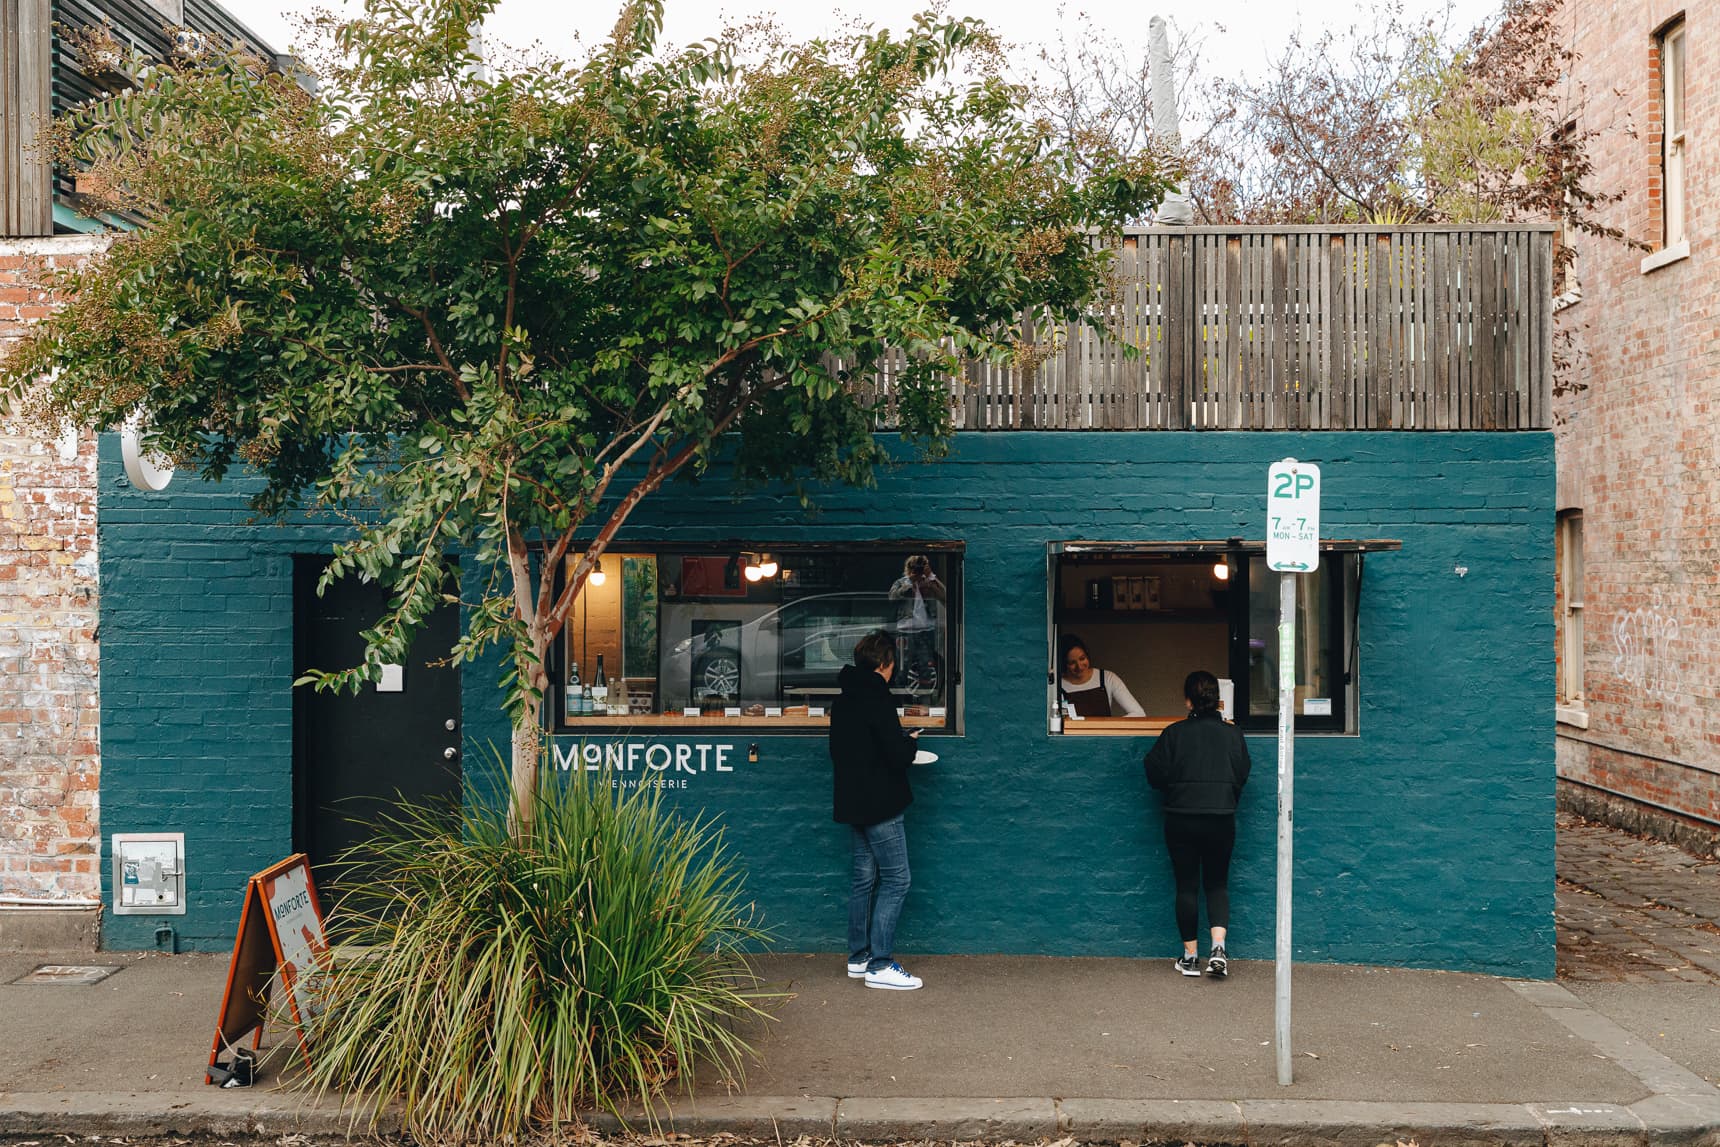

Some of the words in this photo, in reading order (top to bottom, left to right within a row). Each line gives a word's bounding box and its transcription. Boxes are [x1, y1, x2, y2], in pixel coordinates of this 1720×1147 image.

[1274, 473, 1314, 499] 2P
[553, 743, 734, 775] MONFORTE
[274, 890, 309, 921] MONFORTE
